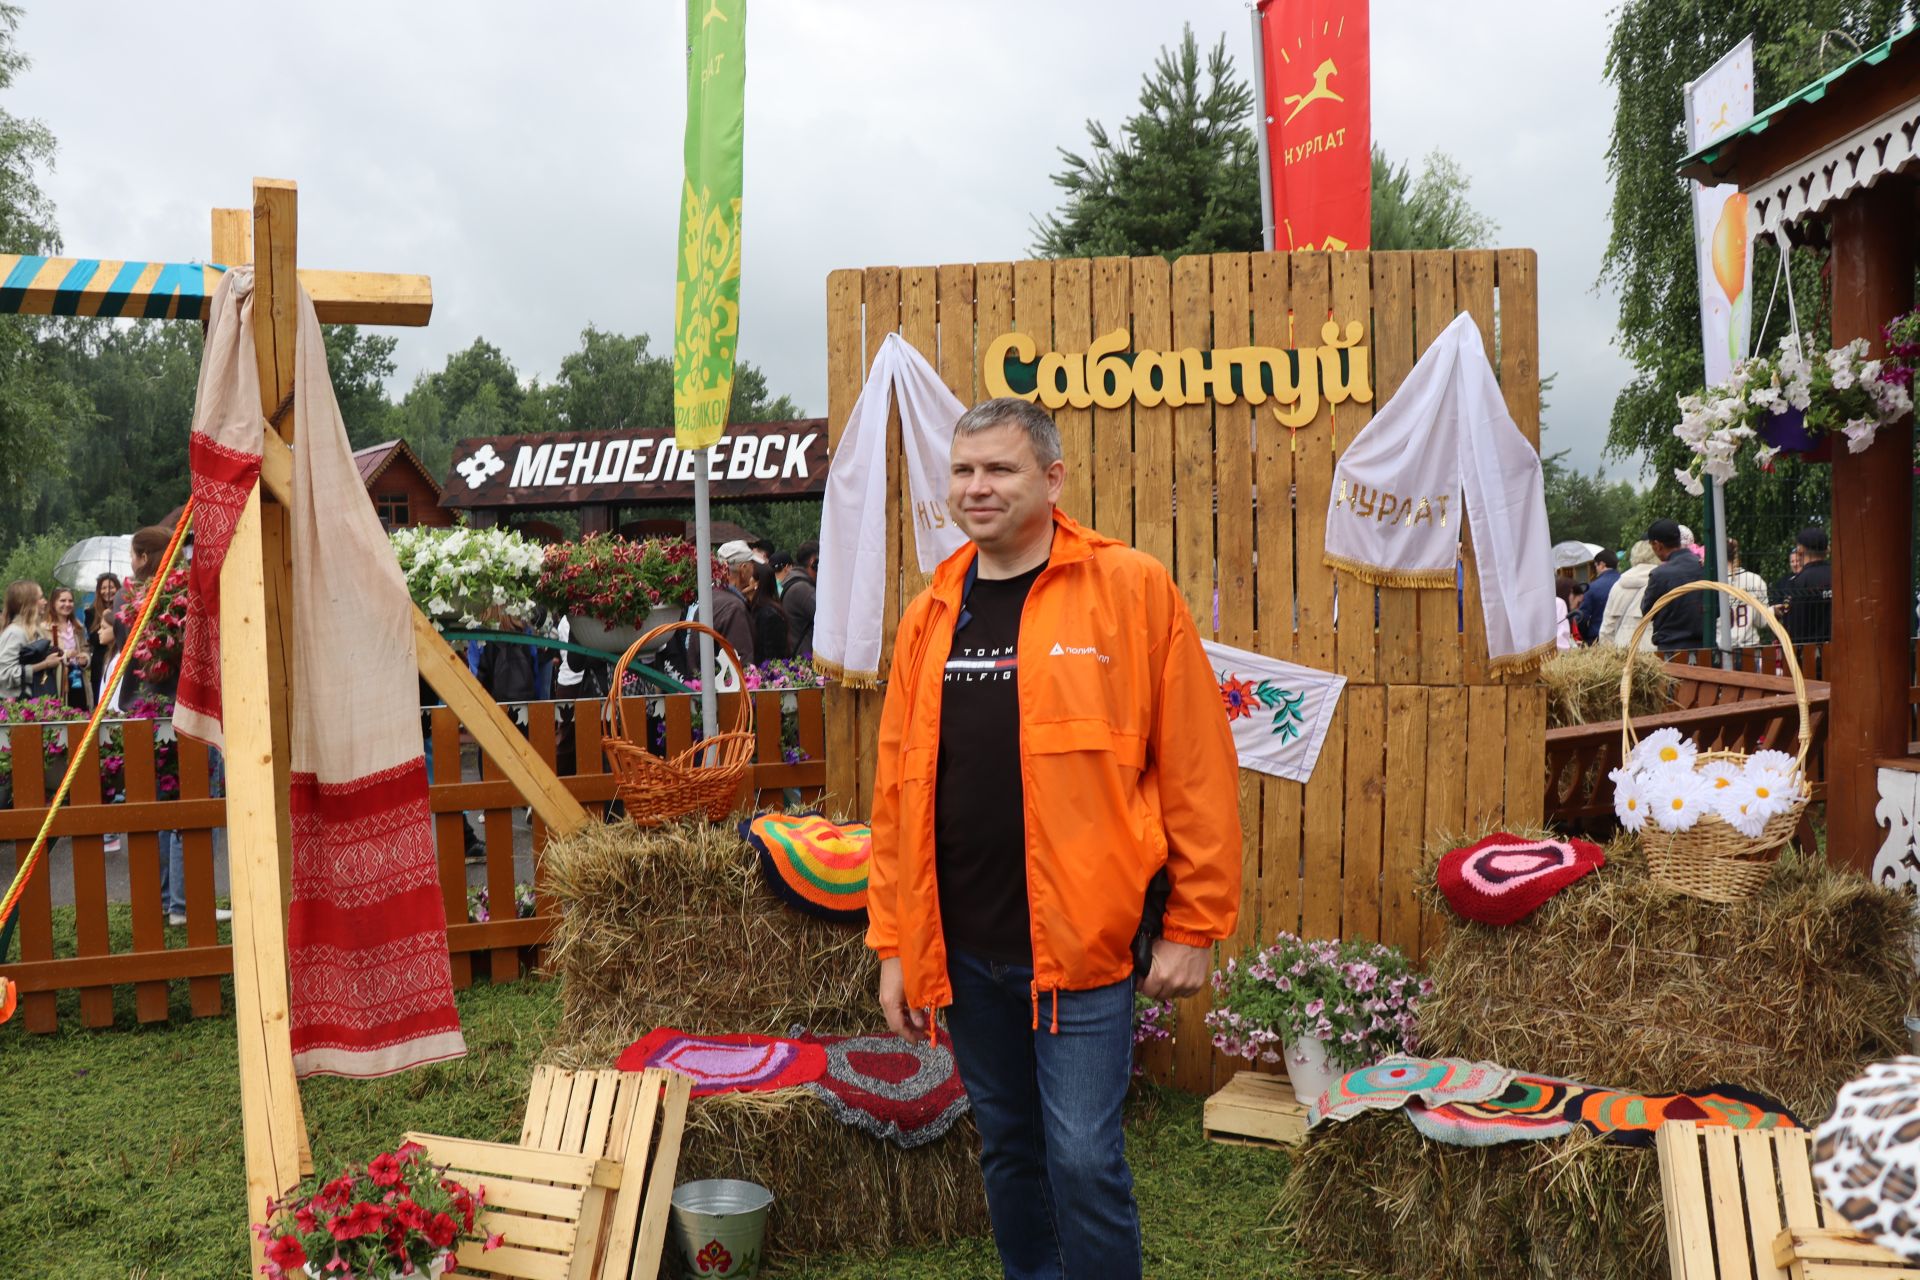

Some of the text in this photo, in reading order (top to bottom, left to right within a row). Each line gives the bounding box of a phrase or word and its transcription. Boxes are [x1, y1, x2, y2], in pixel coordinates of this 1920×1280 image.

[1284, 127, 1346, 167] НУРЛАТ
[984, 320, 1374, 428] Сабантуй
[917, 500, 950, 530] НУ
[1336, 478, 1450, 529] НУРЛАТ
